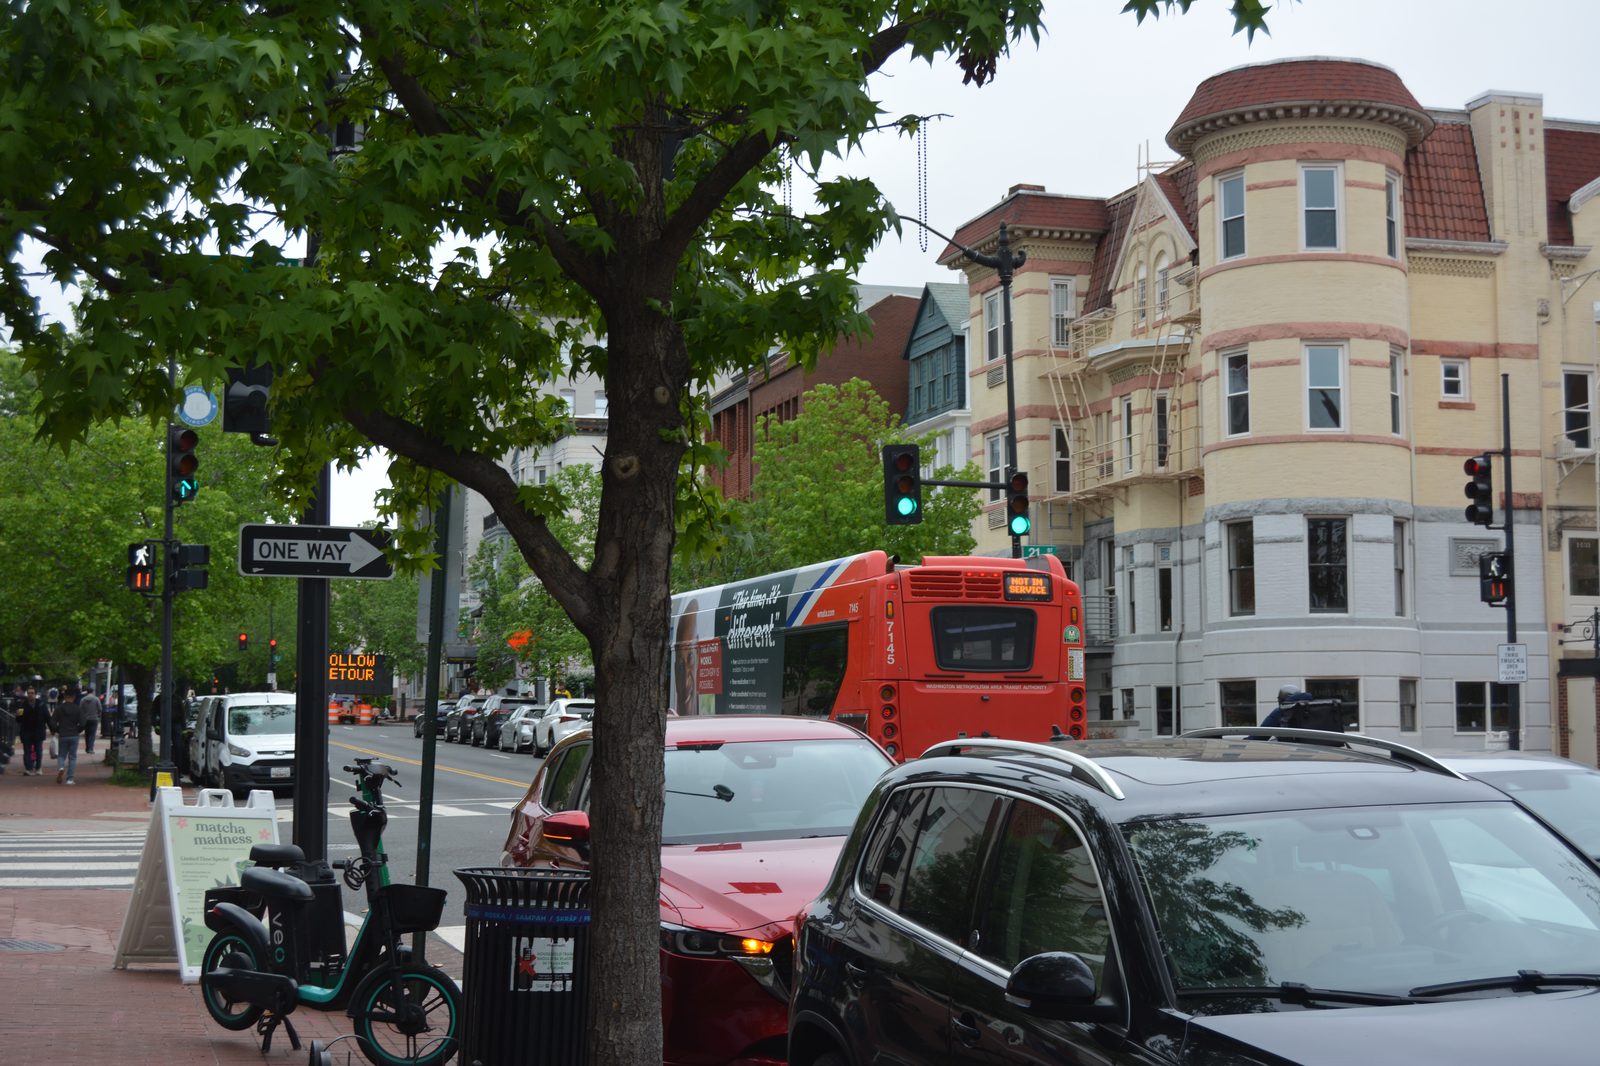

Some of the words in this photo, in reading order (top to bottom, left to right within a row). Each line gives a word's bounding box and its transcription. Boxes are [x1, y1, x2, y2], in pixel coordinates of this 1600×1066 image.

[258, 541, 299, 559] ONE
[307, 543, 347, 560] WAY
[1028, 547, 1040, 557] 21
[136, 572, 151, 587] 11
[1011, 577, 1029, 586] NOT
[1032, 577, 1043, 586] IN
[1009, 585, 1047, 594] SERVICE
[1491, 582, 1503, 597] 11
[886, 621, 895, 665] 7145
[329, 654, 376, 667] OLLOW
[328, 667, 375, 681] ETOUR
[195, 822, 246, 834] matcha
[193, 833, 253, 846] madness
[272, 911, 285, 962] veo
